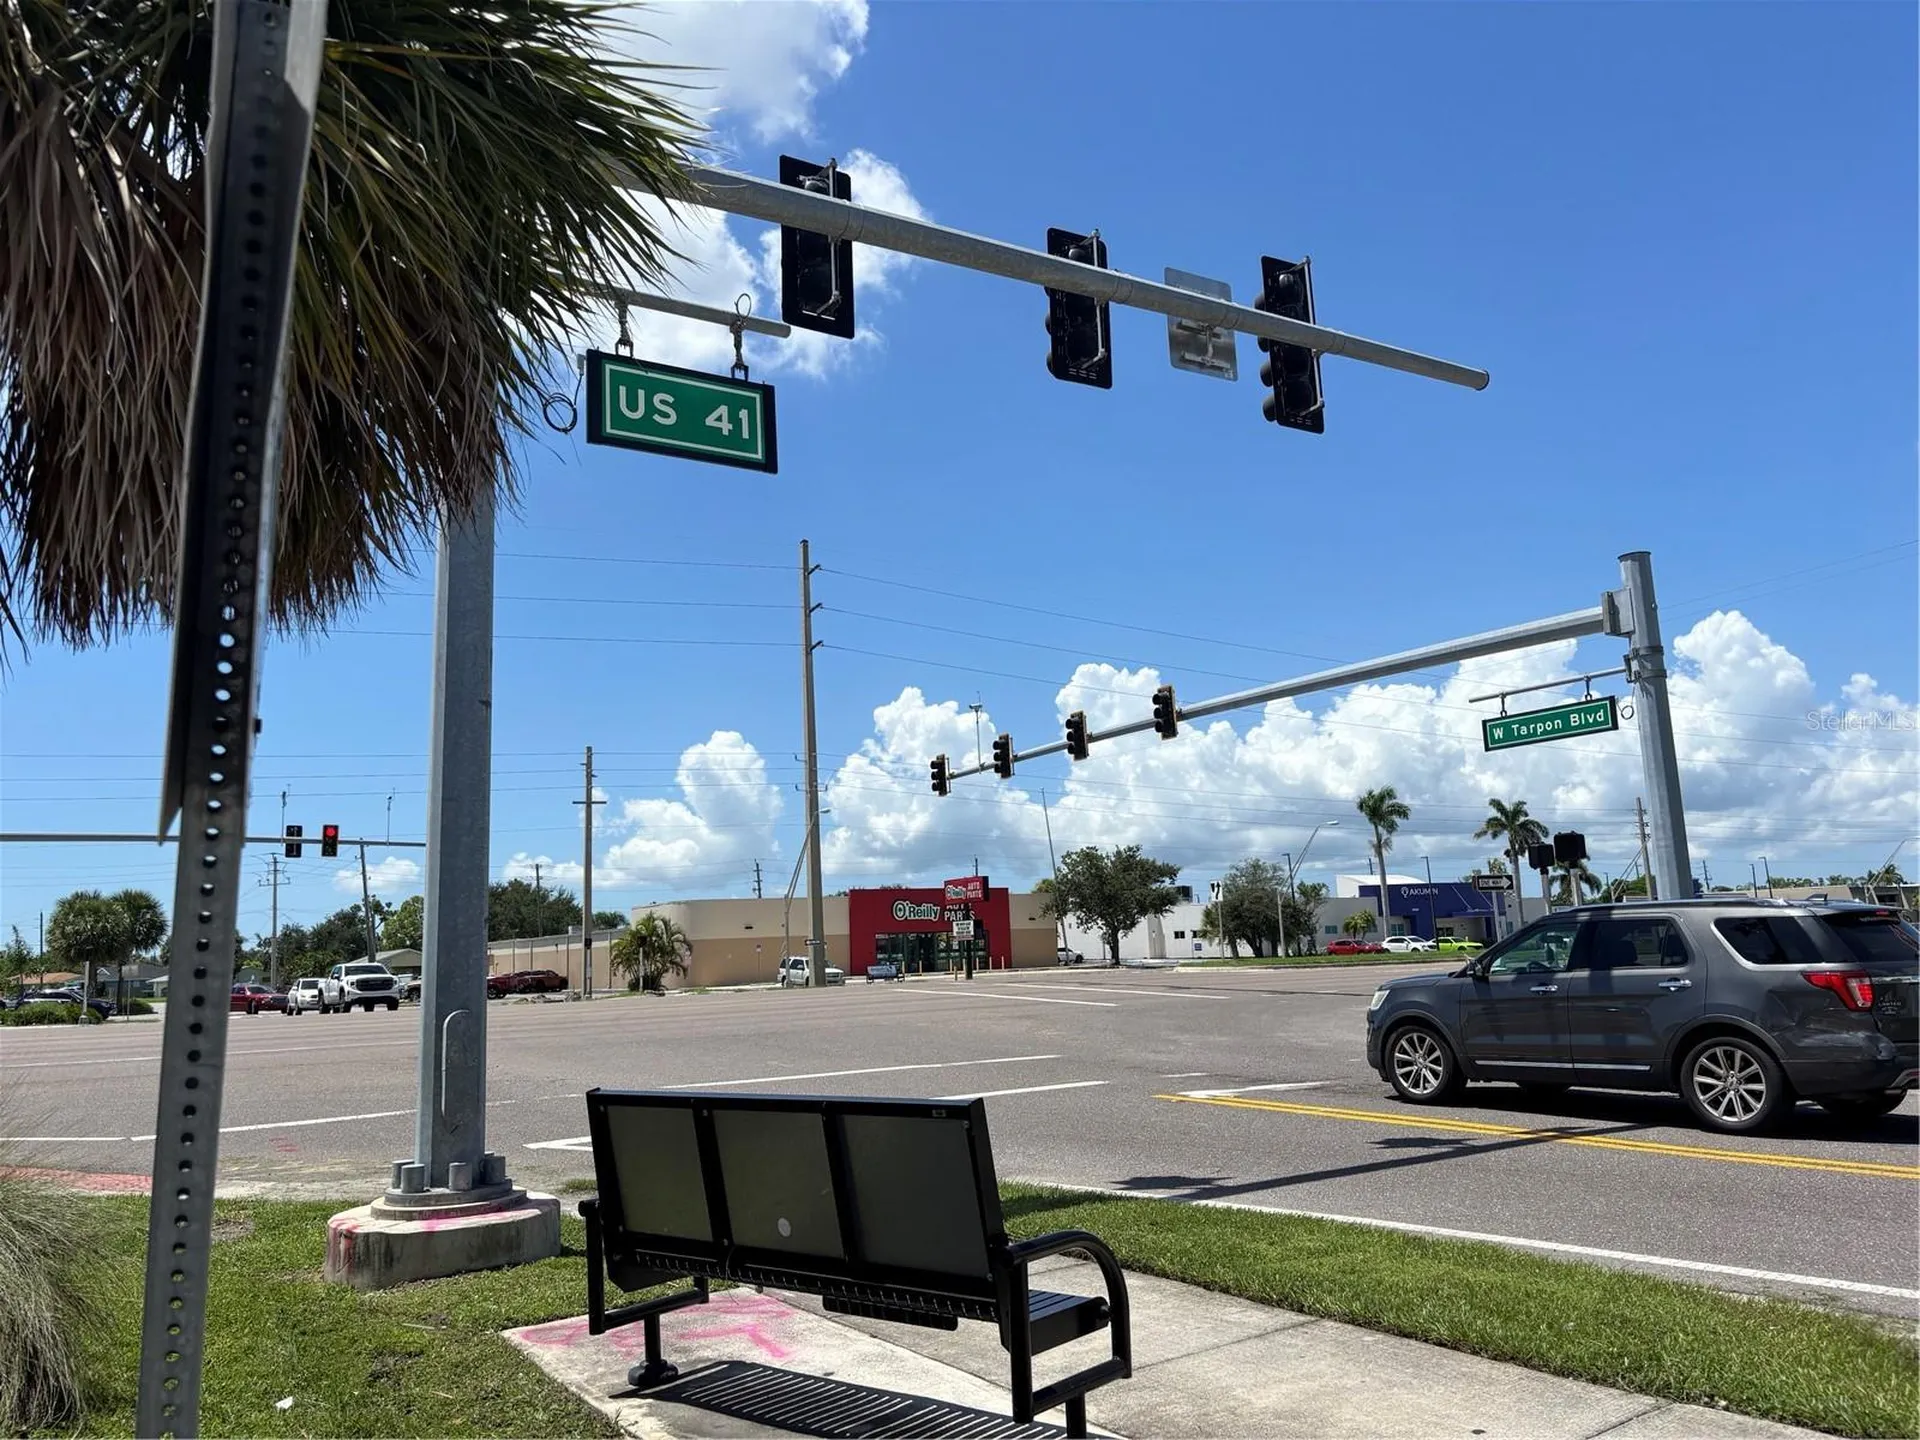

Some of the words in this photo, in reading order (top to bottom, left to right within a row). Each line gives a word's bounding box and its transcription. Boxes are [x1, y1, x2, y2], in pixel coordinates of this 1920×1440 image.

[619, 385, 677, 425] US
[705, 405, 749, 439] 41
[1493, 727, 1504, 740] W
[1512, 719, 1562, 735] Tarpon
[1570, 709, 1604, 726] Blvd
[1409, 888, 1439, 896] AKUMN
[893, 900, 940, 921] O'Reilly
[944, 910, 976, 921] PARS
